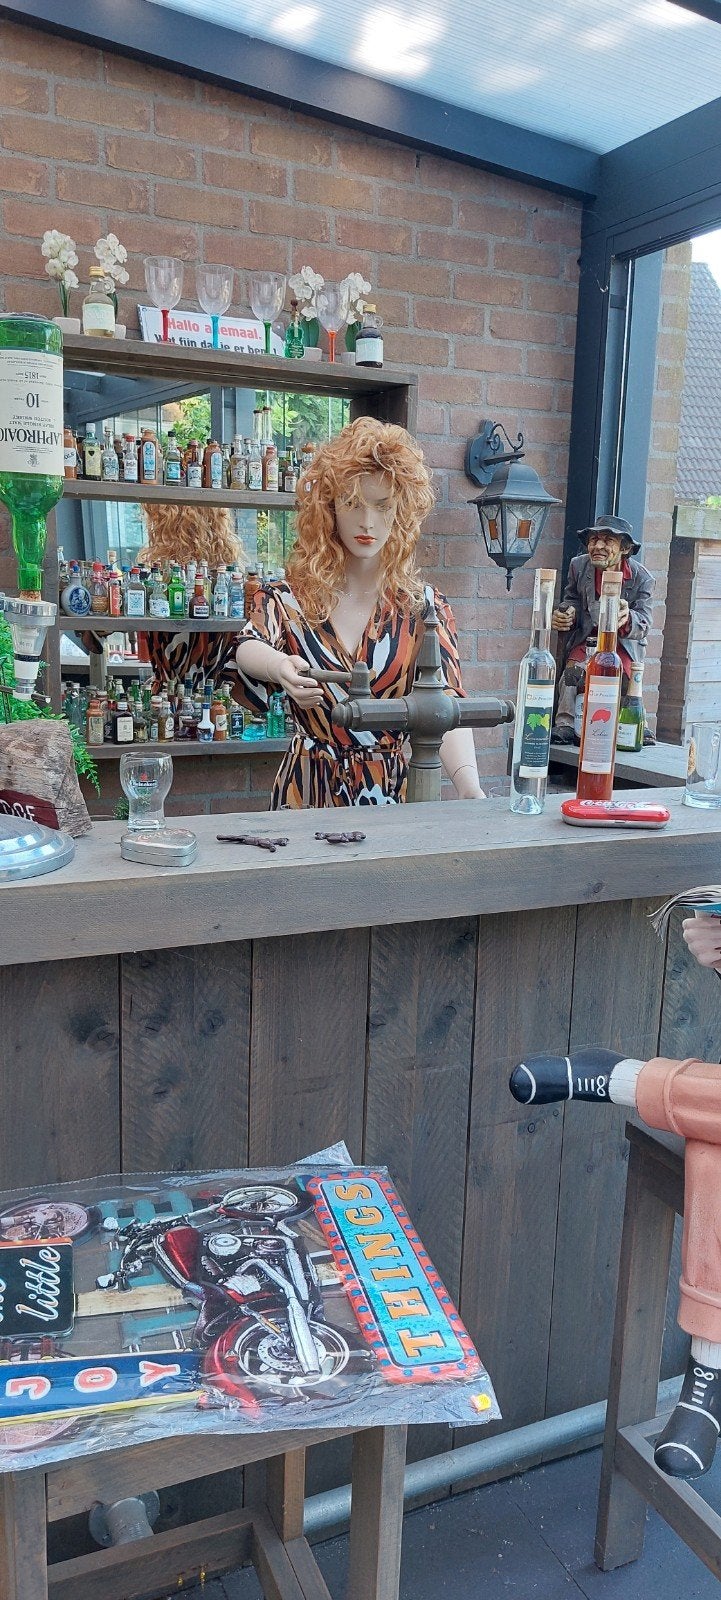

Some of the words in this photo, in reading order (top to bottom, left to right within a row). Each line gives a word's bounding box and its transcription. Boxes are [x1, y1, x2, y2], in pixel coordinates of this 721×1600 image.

[168, 317, 199, 332] Hallo
[205, 323, 262, 340] aemaal.
[201, 340, 216, 348] da
[234, 345, 244, 353] er
[26, 392, 40, 408] 10
[332, 1183, 446, 1358] THINGS
[15, 1246, 61, 1322] little
